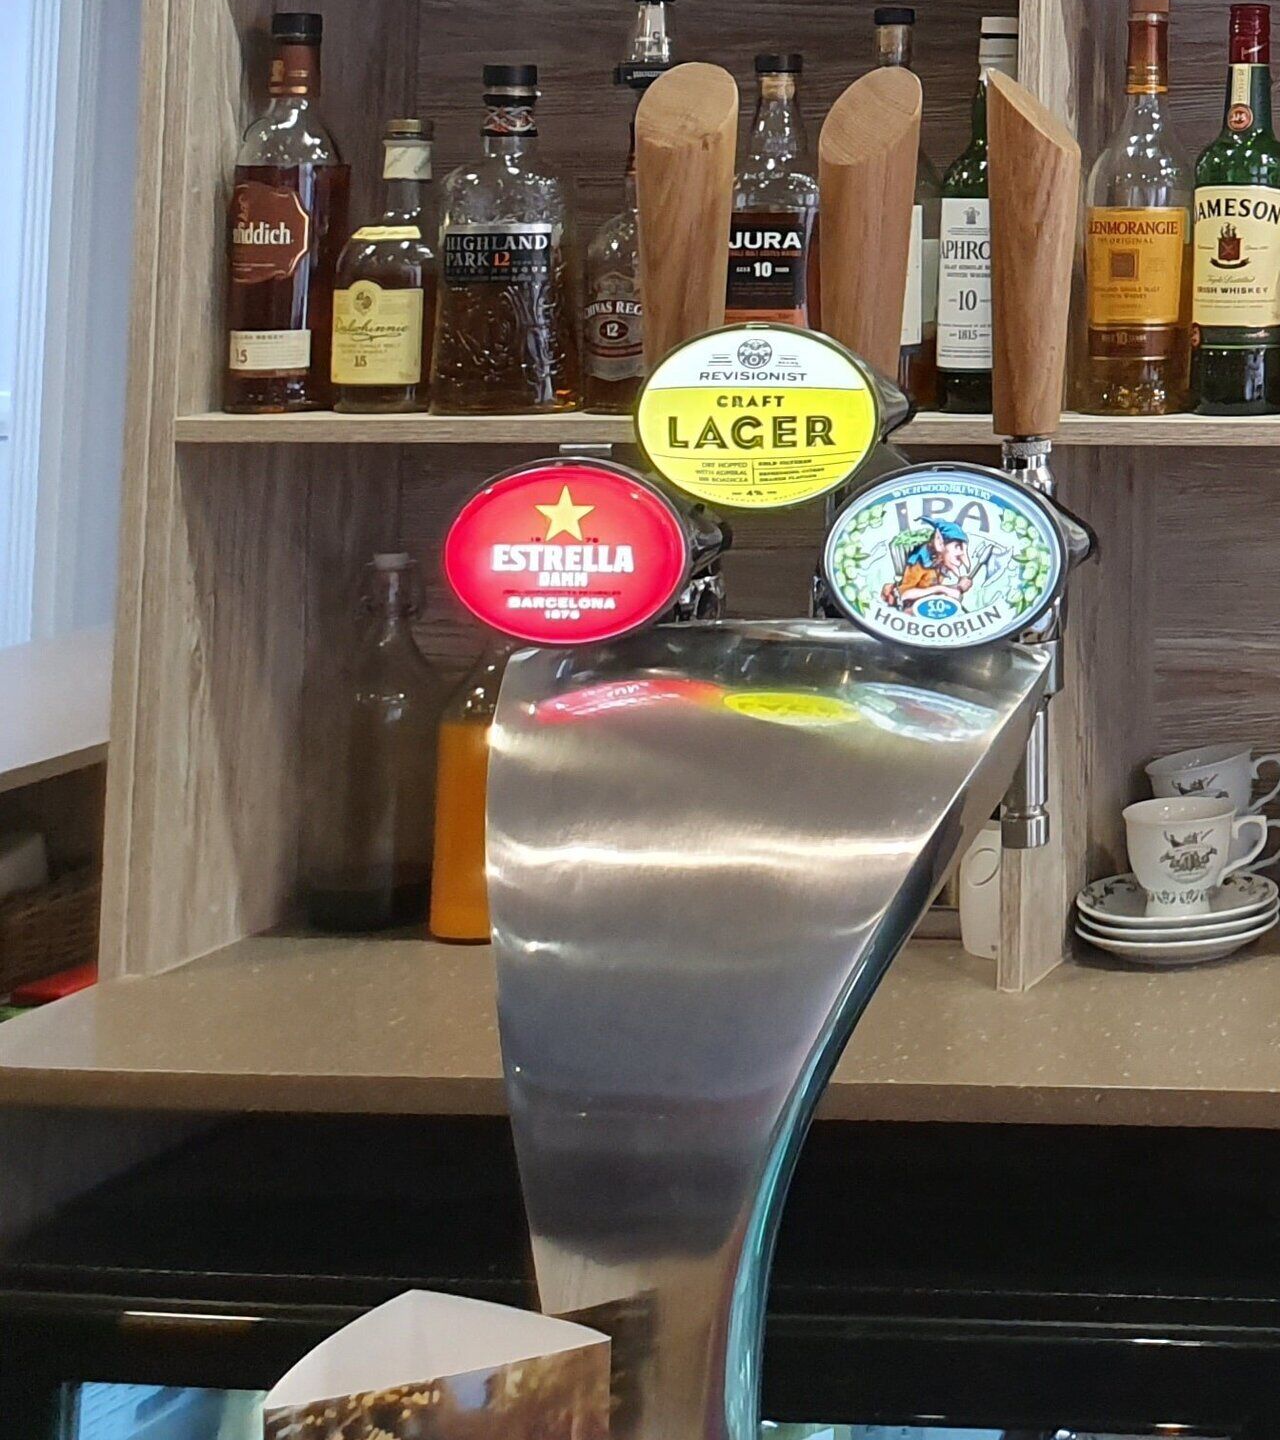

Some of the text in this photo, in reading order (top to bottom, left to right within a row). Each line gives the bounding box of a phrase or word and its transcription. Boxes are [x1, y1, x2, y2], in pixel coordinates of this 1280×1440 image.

[446, 234, 549, 251] HIGHLAND
[729, 230, 803, 251] JURA
[446, 250, 511, 267] PARK 12
[753, 261, 772, 277] 10
[1220, 285, 1269, 295] WHISKEY
[957, 289, 977, 312] 10
[605, 321, 620, 337] 12
[957, 329, 979, 341] 1815
[354, 354, 368, 367] 15
[698, 371, 808, 383] REVISIONIST
[716, 395, 786, 408] CRAFT
[668, 415, 837, 451] LAGER
[745, 488, 764, 497] 4%
[894, 497, 991, 534] IPA
[490, 543, 636, 574] ESTRELLA
[537, 571, 590, 588] DAMM
[506, 596, 617, 611] BARCELONA
[543, 609, 582, 620] 1876
[874, 604, 1002, 639] HOBGOBLIN
